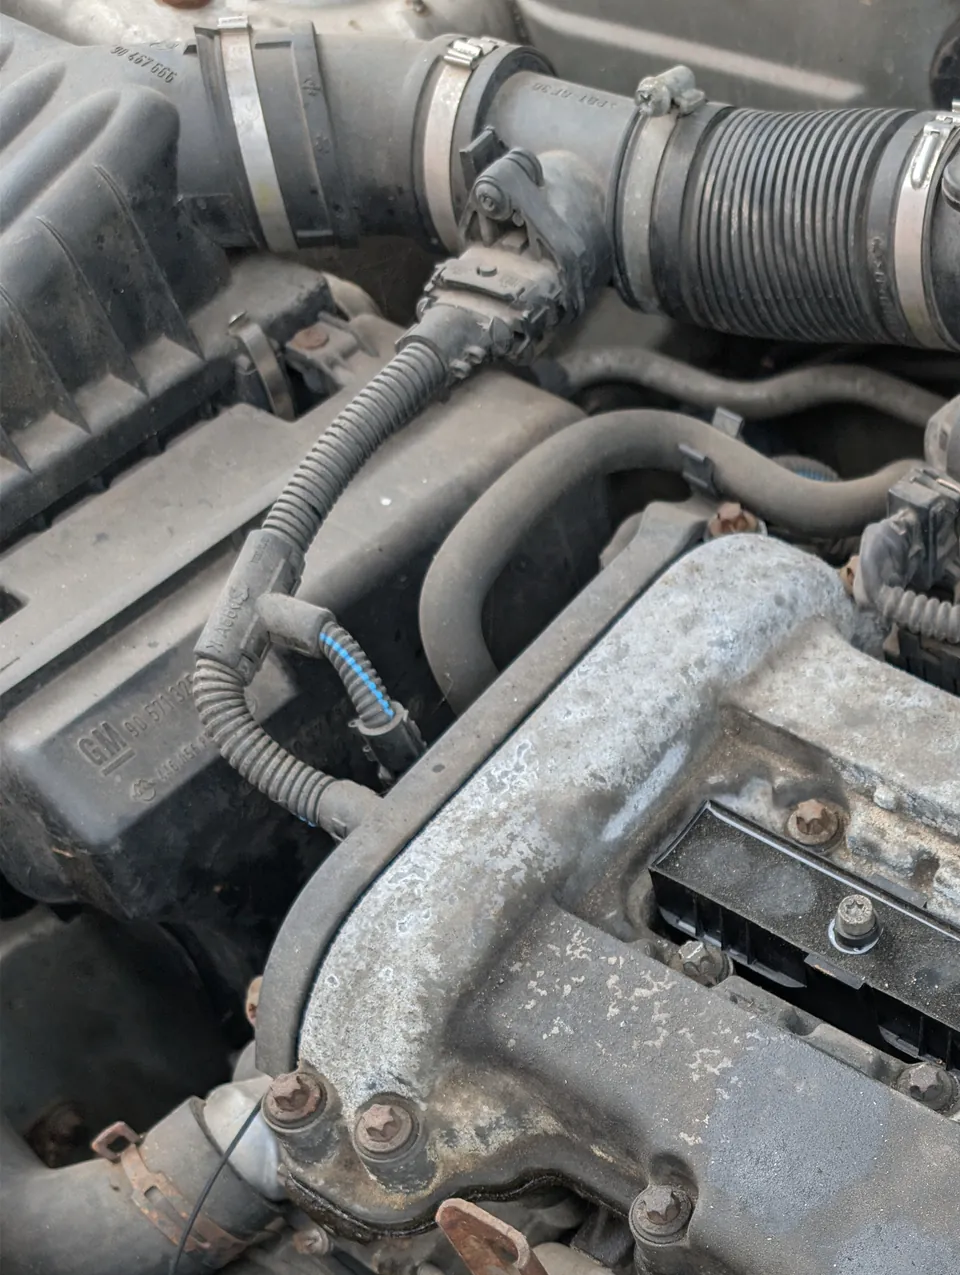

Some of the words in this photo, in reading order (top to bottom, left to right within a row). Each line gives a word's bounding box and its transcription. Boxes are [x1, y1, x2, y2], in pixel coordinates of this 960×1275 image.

[78, 721, 129, 767] GM
[123, 716, 147, 738] 90
[145, 694, 176, 722] 571
